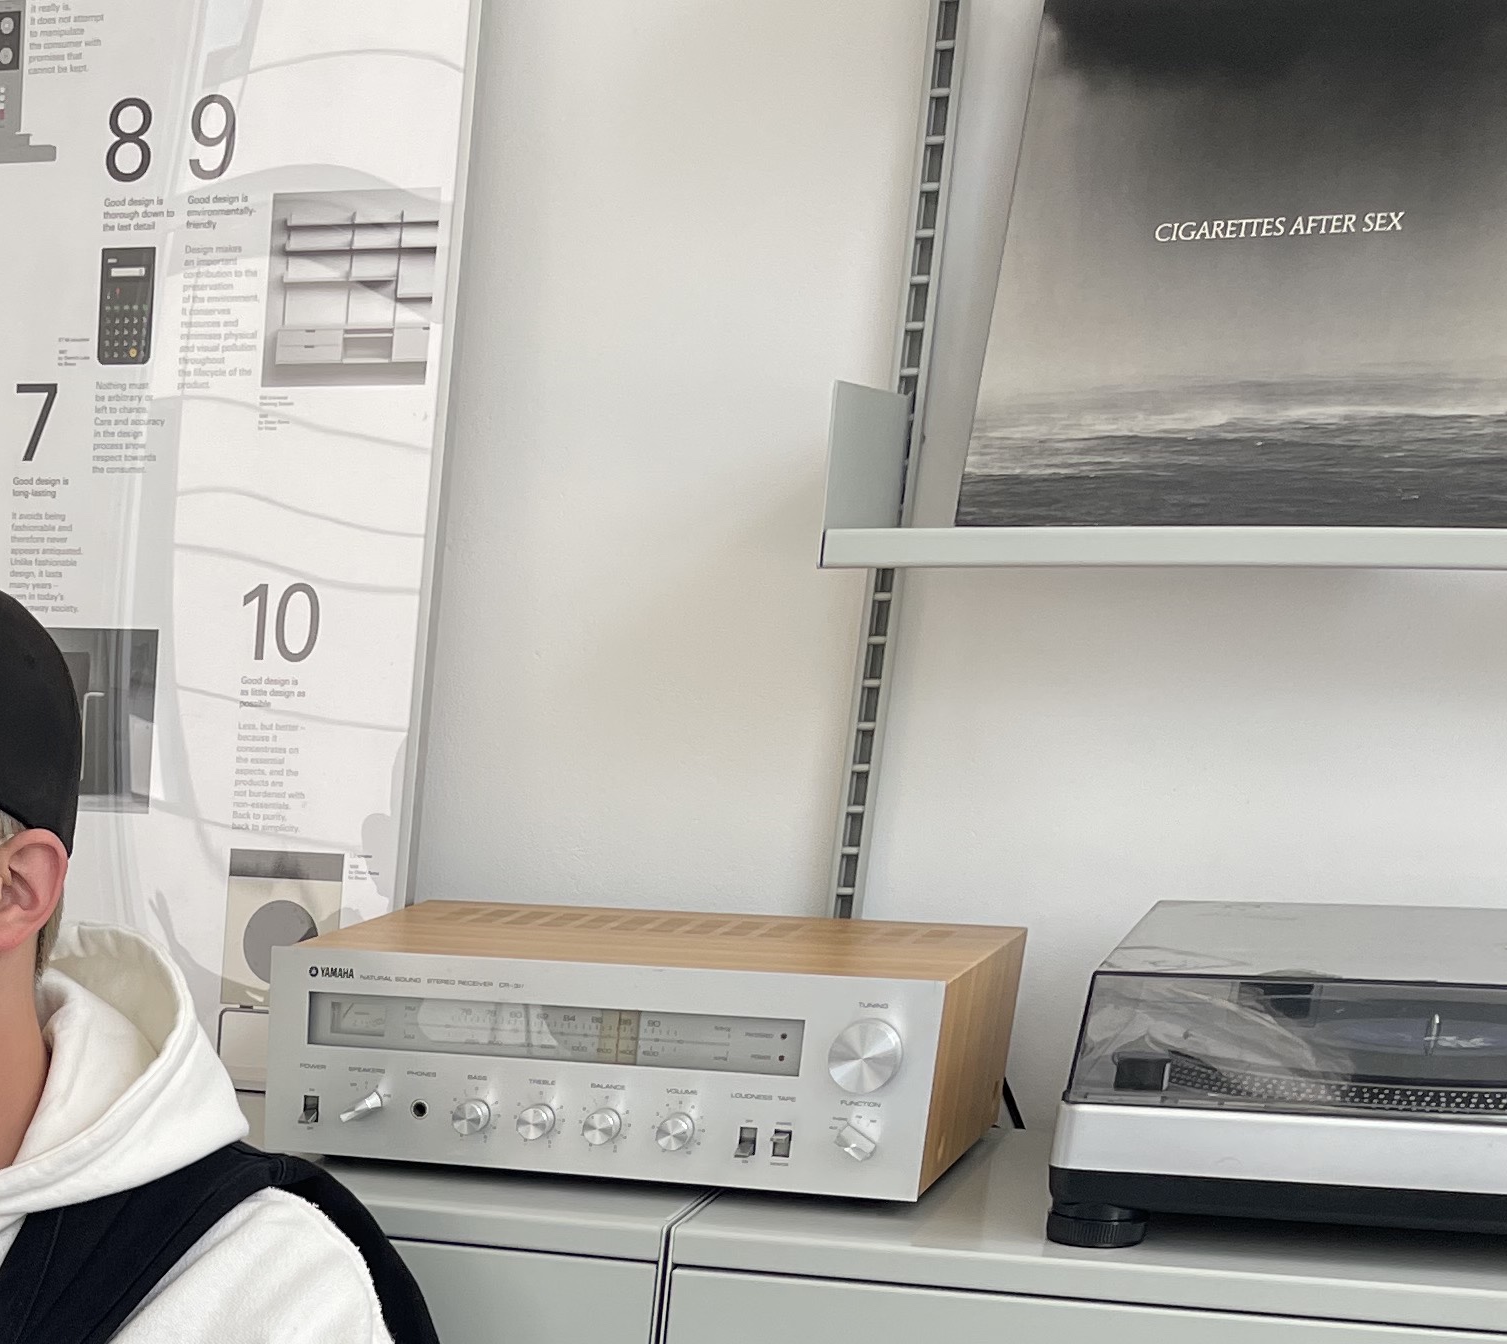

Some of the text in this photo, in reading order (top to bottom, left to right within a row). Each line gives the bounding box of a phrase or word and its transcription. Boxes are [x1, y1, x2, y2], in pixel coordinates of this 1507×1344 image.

[106, 97, 152, 182] 8
[189, 94, 236, 180] 9
[104, 197, 164, 208] Good design is
[188, 194, 248, 205] Good design is
[103, 208, 175, 221] thorough down to
[103, 222, 156, 231] the last detail
[186, 220, 216, 230] friendly
[1154, 211, 1405, 242] CIGARETTES AFTER SEX
[16, 383, 58, 462] 7
[13, 477, 69, 487] Good design is
[12, 488, 56, 499] long-lasting
[242, 582, 320, 663] 10
[241, 676, 298, 687] Good design is
[251, 688, 268, 696] little
[269, 688, 295, 699] design
[320, 967, 355, 979] YAMAHA
[395, 976, 421, 984] SOUND
[528, 1078, 556, 1086] TREBLE
[590, 1083, 626, 1091] BALANCE
[777, 1095, 797, 1103] TAPE
